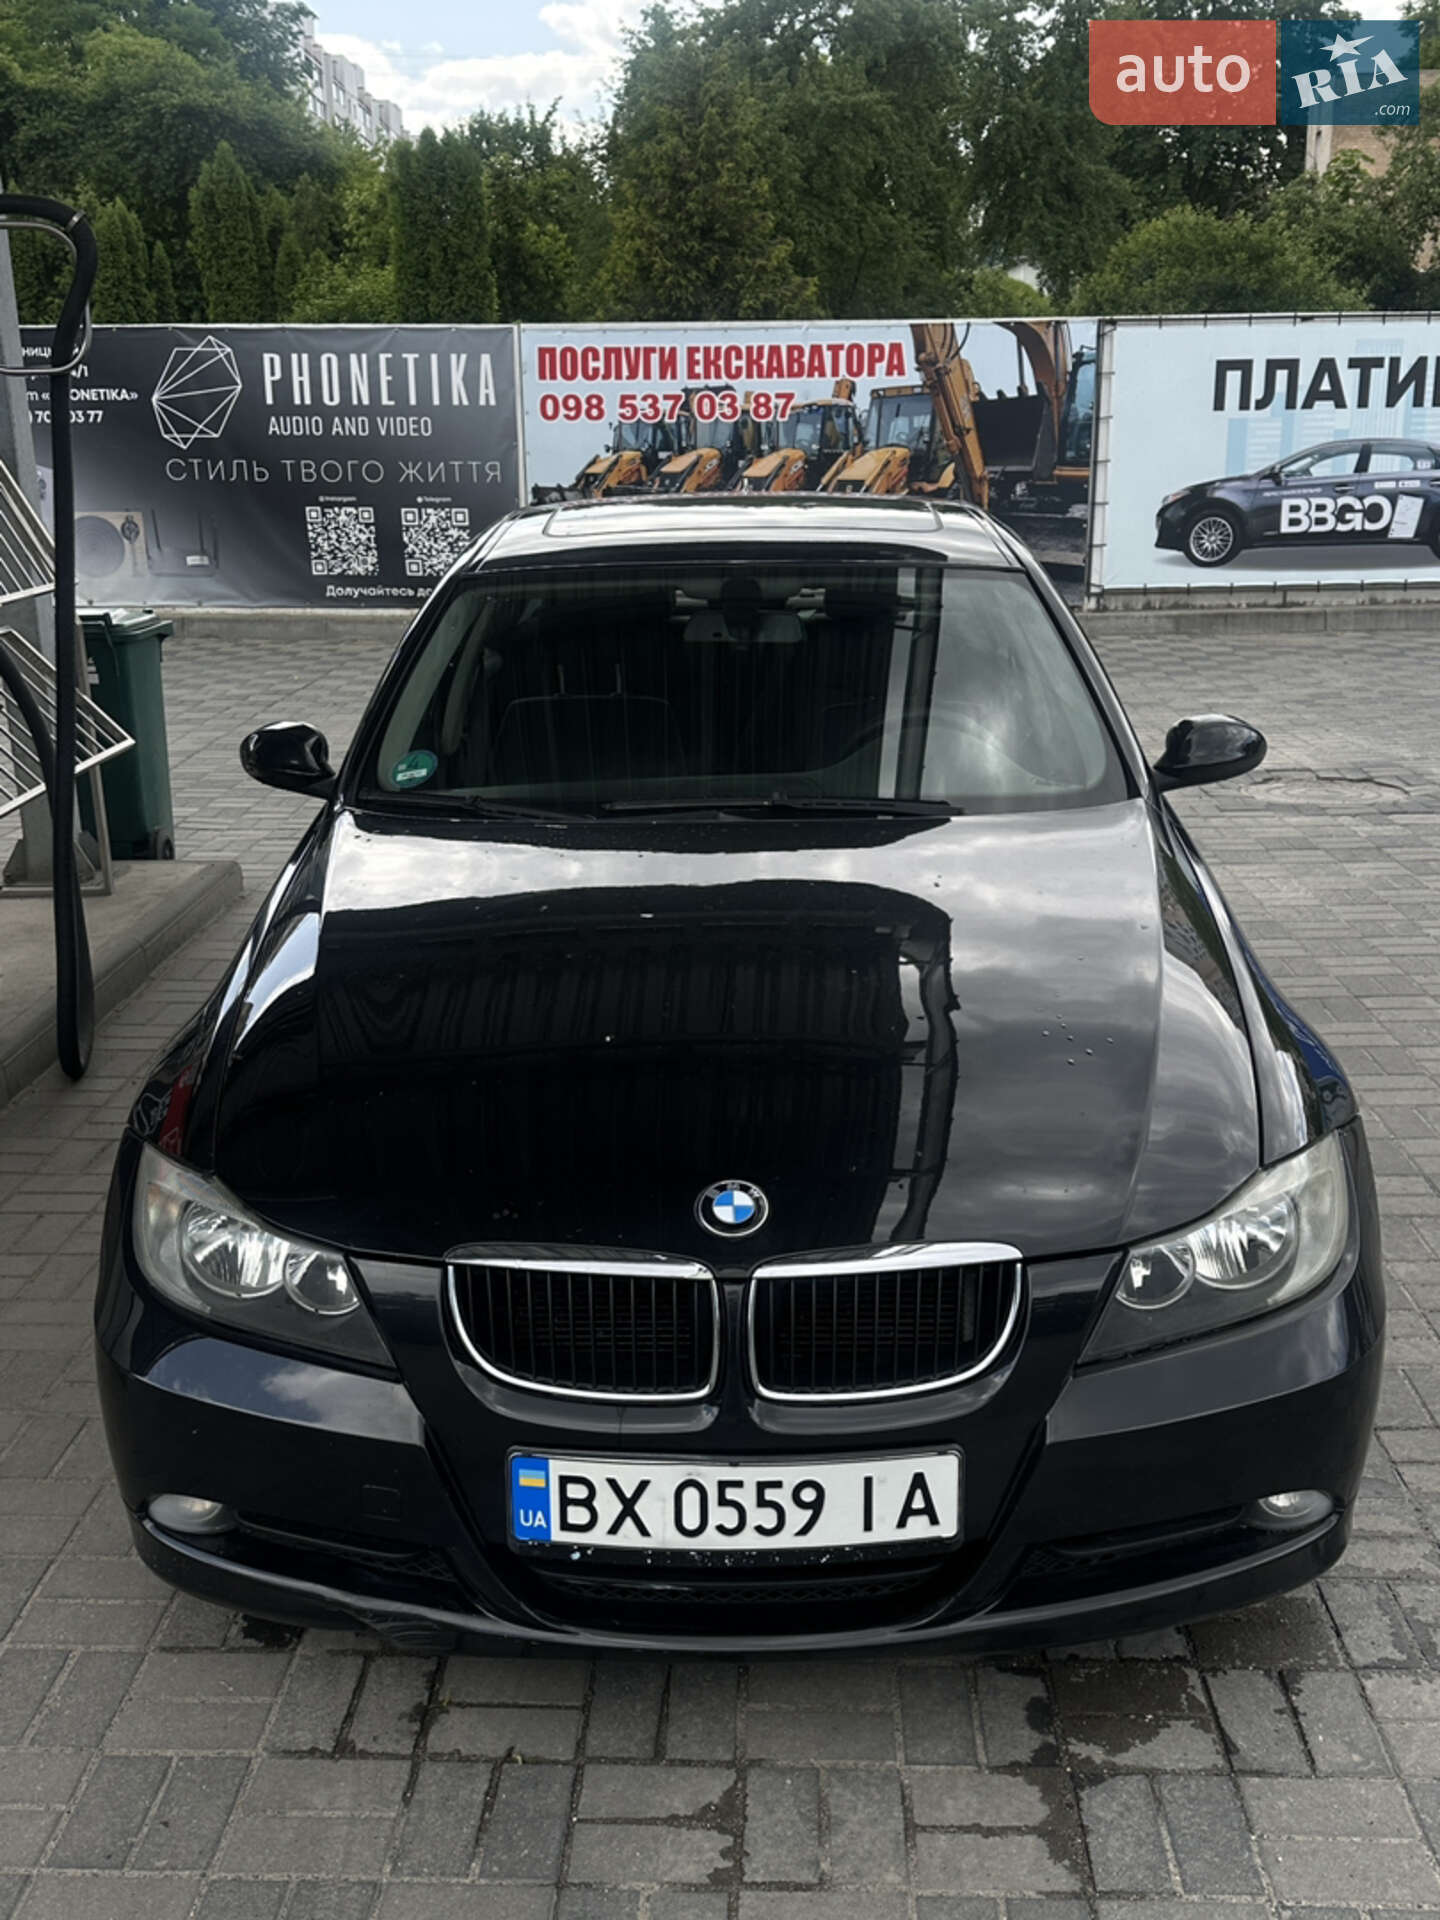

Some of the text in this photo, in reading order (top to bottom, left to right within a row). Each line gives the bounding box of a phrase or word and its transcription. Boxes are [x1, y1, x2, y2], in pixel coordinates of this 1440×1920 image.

[537, 342, 906, 381] ПОСЛУГИ ЕКСКАВАТОРА
[263, 353, 497, 406] PHONETIKA
[86, 410, 104, 423] 77
[540, 392, 796, 421] 098 537 03 87
[268, 416, 432, 437] AUDIO AND VIDEO
[165, 458, 501, 483] СТИЛЬ ТВОГО ЖИТТЯ
[1280, 495, 1393, 534] BBGO
[326, 585, 415, 598] Долучайтесь
[519, 1509, 547, 1529] UA
[558, 1475, 652, 1537] BX
[673, 1478, 826, 1537] 0559
